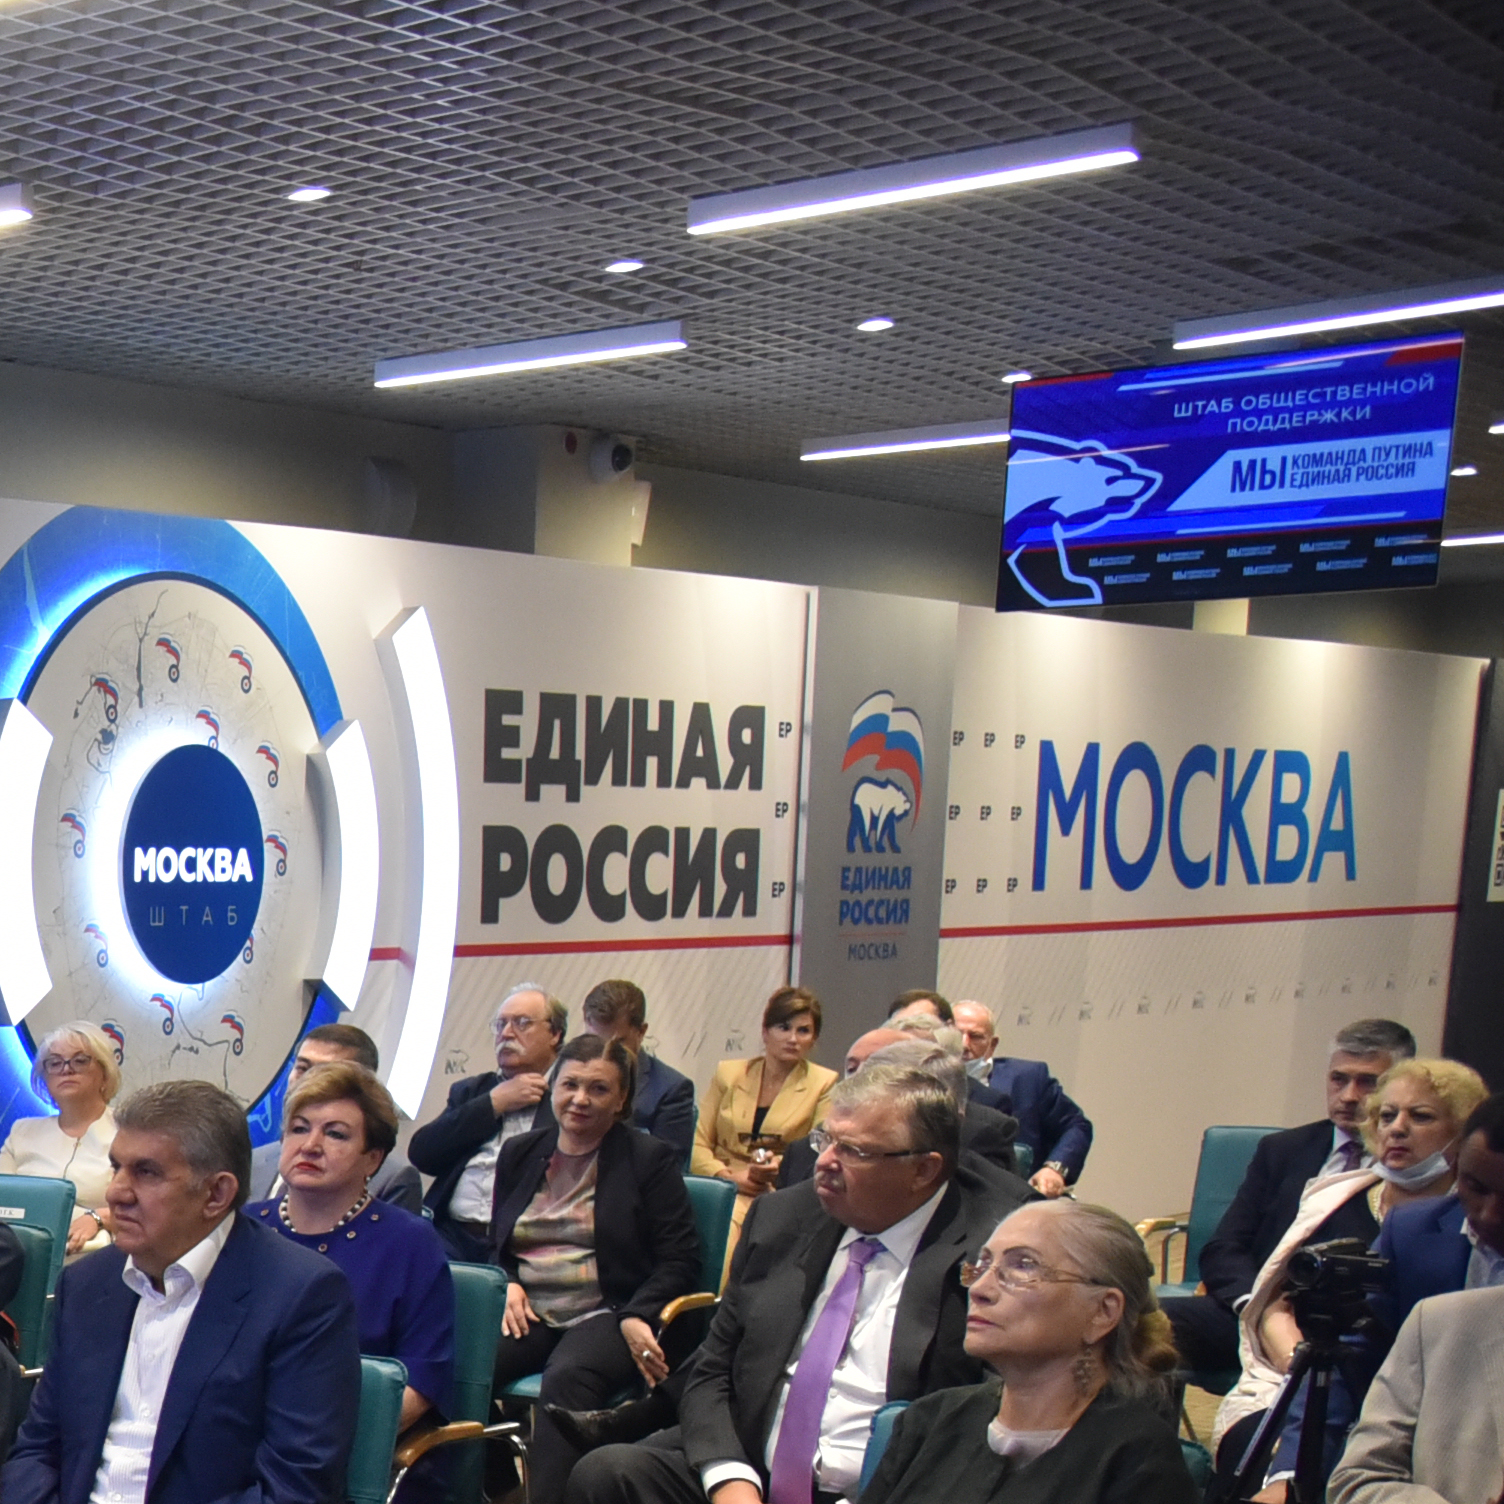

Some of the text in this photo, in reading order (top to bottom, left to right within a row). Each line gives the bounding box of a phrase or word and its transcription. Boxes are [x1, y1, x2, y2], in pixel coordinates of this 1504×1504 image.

[1173, 373, 1434, 418] ШТАБ ОБЩЕСТВЕННОЙ
[1227, 405, 1371, 433] ПОДДЕРЖКИ
[1291, 441, 1434, 471] КОМАНДА ПУТИНА
[1230, 455, 1288, 493] МЫ
[1291, 461, 1416, 490] ЕДИНАЯ РОССИЯ
[483, 688, 766, 803] ЕДИНАЯ
[1032, 740, 1357, 892] МОСКВА
[134, 846, 253, 883] МОСКВА
[480, 824, 761, 924] РОССИЯ
[840, 866, 911, 893] ЕДИНАЯ
[150, 905, 238, 926] ШТАБ
[838, 899, 910, 926] РОССИЯ
[848, 942, 898, 960] МОСКВА
